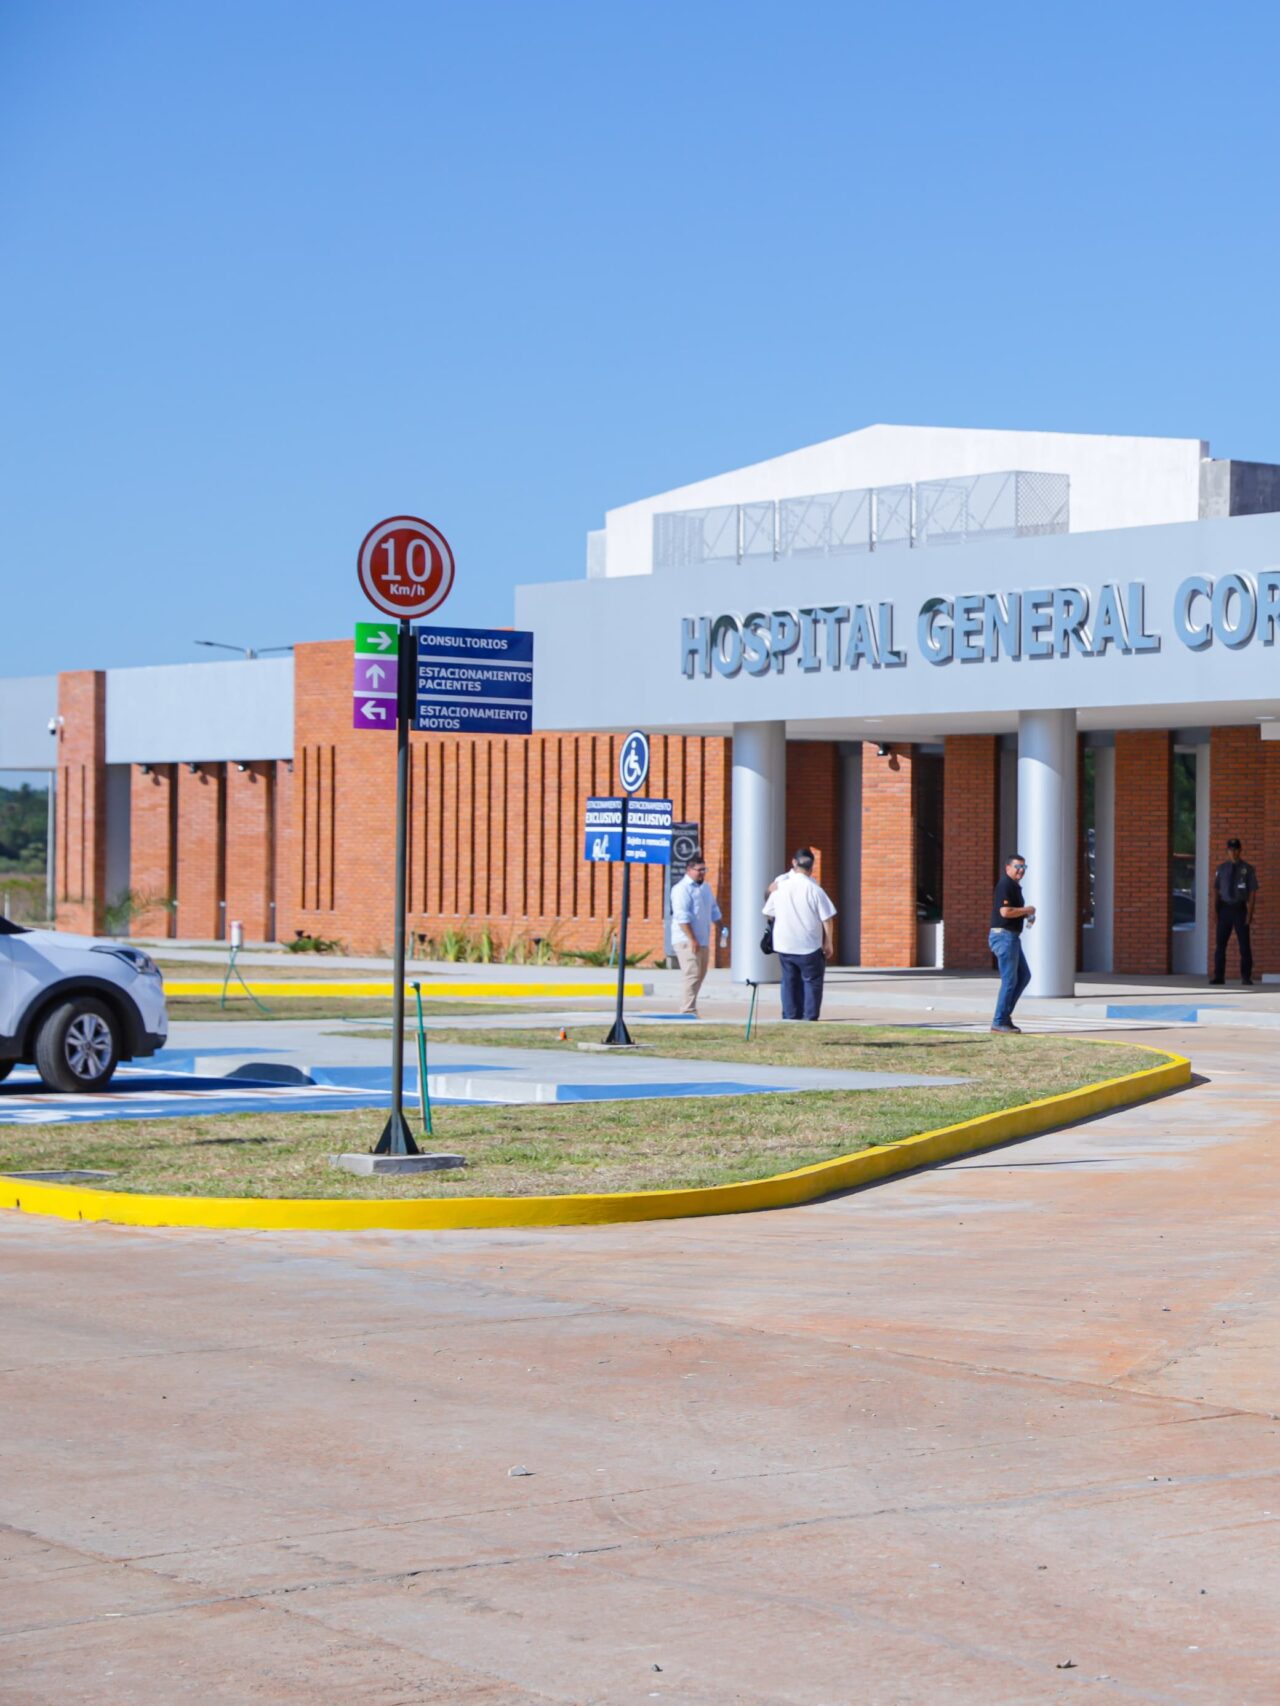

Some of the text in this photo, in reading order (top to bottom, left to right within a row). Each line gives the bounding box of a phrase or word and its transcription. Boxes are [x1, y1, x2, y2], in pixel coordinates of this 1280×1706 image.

[380, 538, 432, 582] 10
[389, 583, 425, 597] Km/h
[681, 601, 907, 678] HOSPITAL
[917, 581, 1161, 666] GENERAL
[420, 634, 508, 650] CONSULTORIOS
[419, 666, 532, 682] ESTACIONAMIENTOS
[418, 680, 482, 692] PACIENTES
[419, 705, 528, 721] ESTACIONAMIENTO
[419, 715, 460, 729] MOTOS
[586, 812, 622, 824] EXCLUSIVO
[627, 812, 671, 826] EXCLUSIVO
